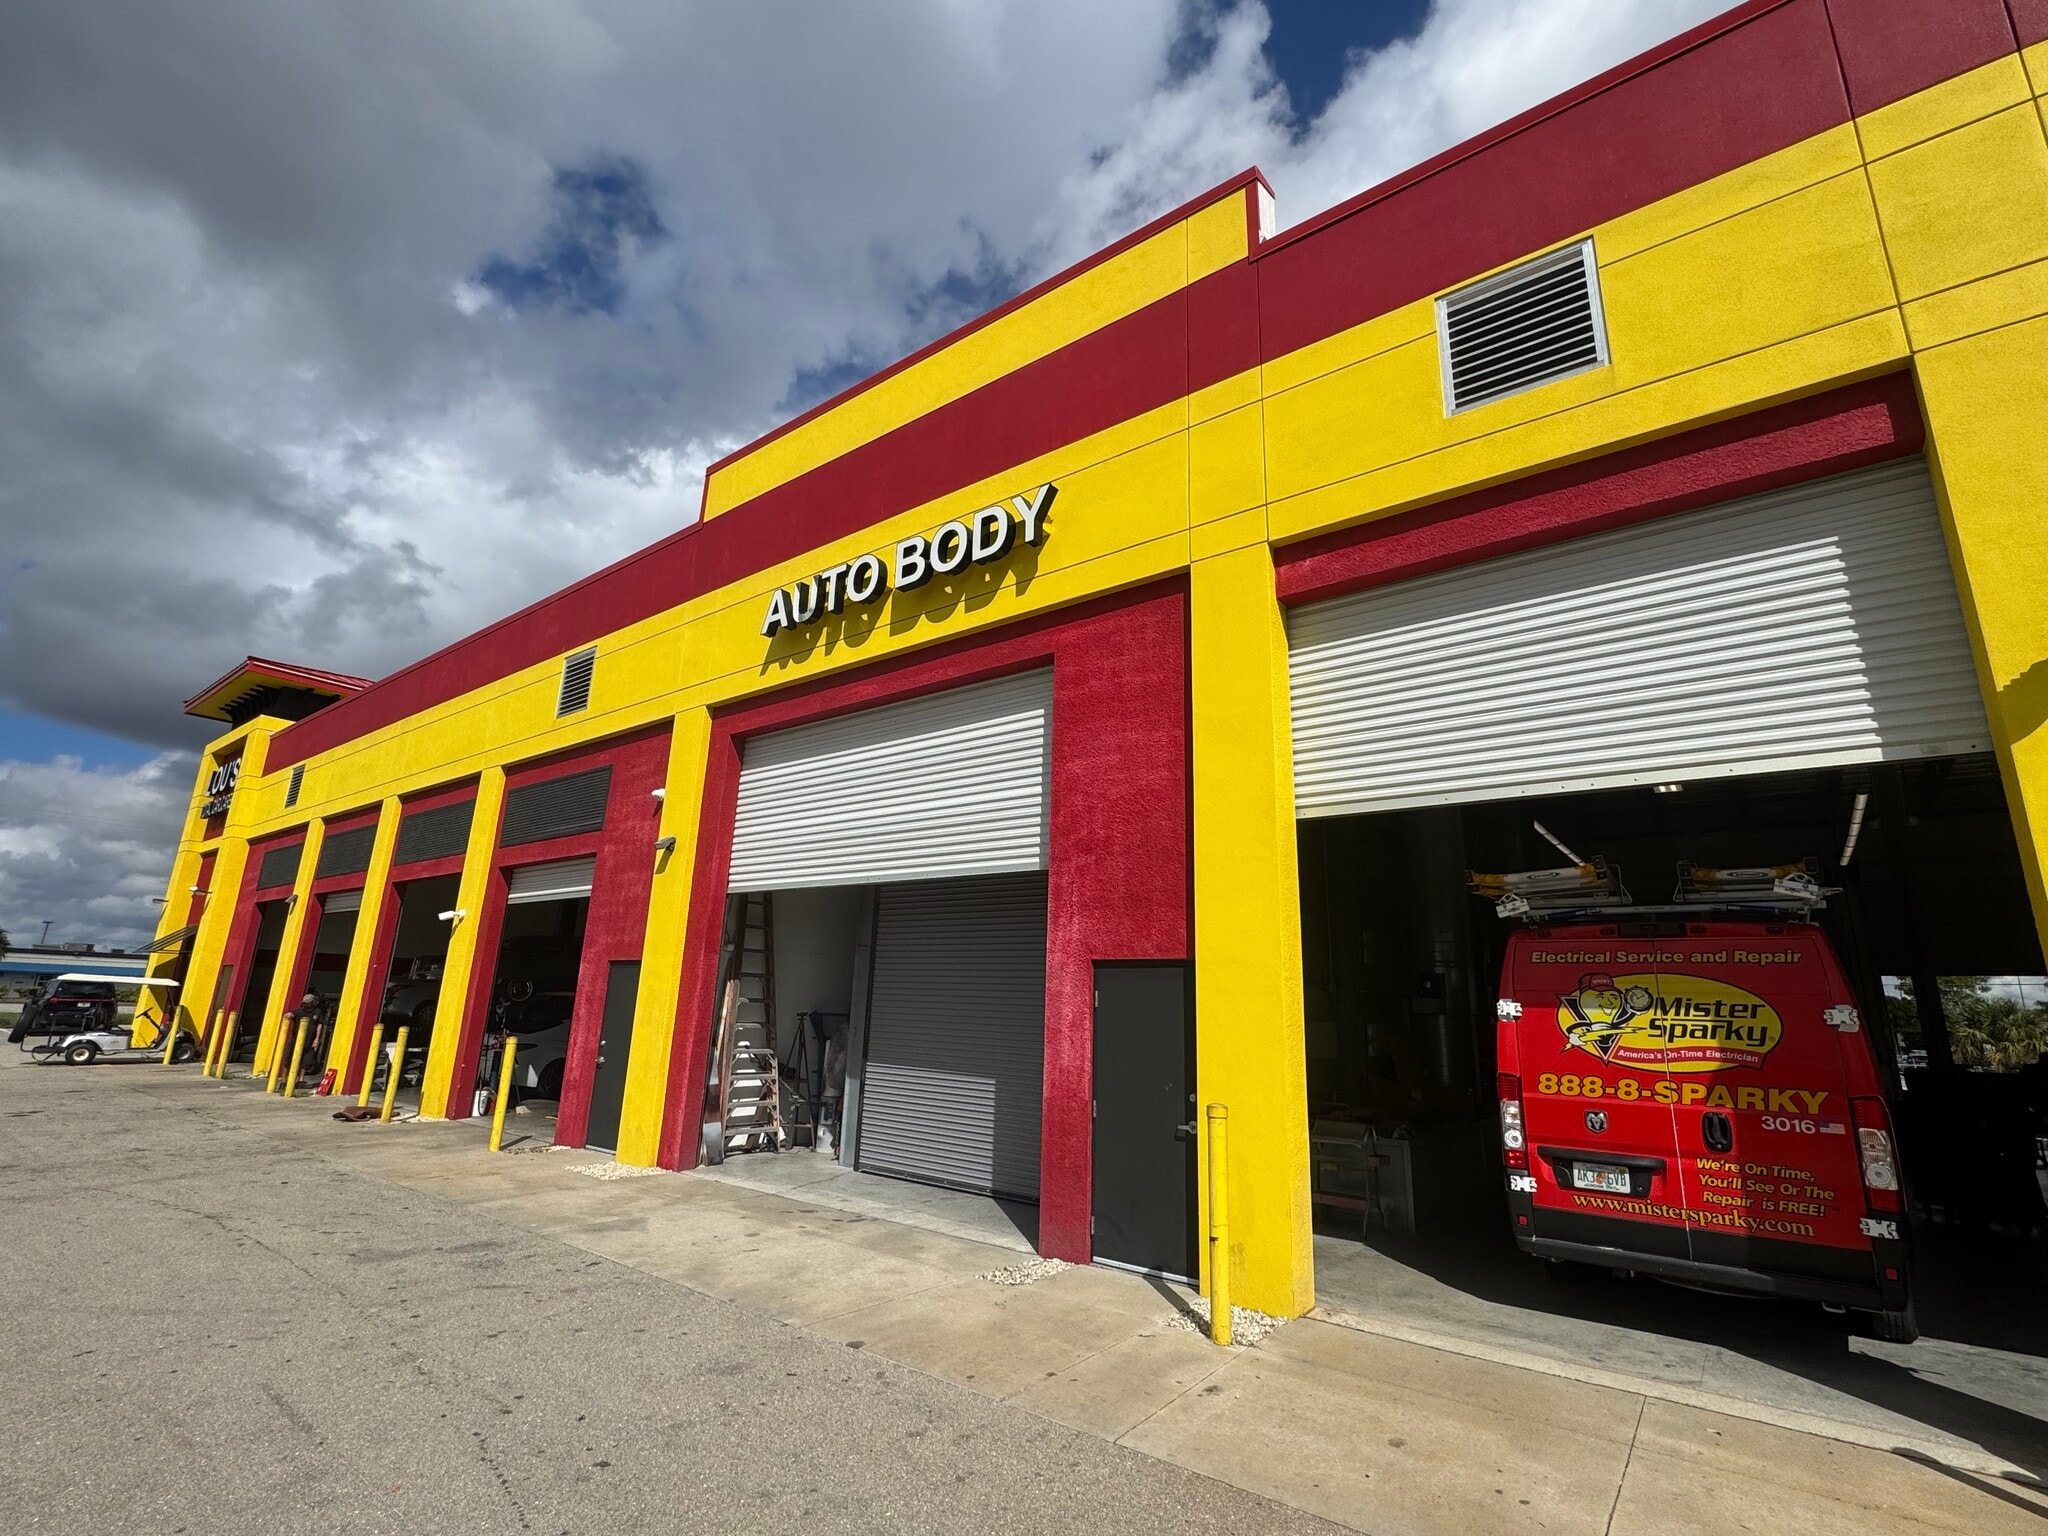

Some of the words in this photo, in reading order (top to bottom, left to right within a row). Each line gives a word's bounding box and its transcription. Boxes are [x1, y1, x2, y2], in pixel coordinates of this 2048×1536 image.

[760, 553, 883, 637] AUTO
[895, 482, 1055, 591] BODY
[1531, 950, 1611, 963] Electrical
[1615, 950, 1685, 964] Service
[1690, 950, 1727, 964] and
[1733, 950, 1803, 967] Repair
[1653, 996, 1766, 1020] Mister
[1647, 1018, 1768, 1048] Sparky
[1617, 1049, 1662, 1060] America's
[1663, 1050, 1705, 1060] On-Time
[1706, 1050, 1759, 1063] Electrician
[1537, 1072, 1830, 1115] 888-8-SPARKY
[1761, 1115, 1816, 1135] 3016
[1696, 1157, 1741, 1173] We're
[1744, 1163, 1768, 1176] On
[1771, 1165, 1815, 1182] Time,
[1699, 1174, 1742, 1190] You'll
[1745, 1179, 1775, 1193] See
[1780, 1183, 1800, 1196] Or
[1804, 1186, 1835, 1200] The
[1573, 1194, 1815, 1237] www.mistersparky.com
[1703, 1191, 1754, 1207] Repair
[1762, 1197, 1775, 1211] is
[1779, 1200, 1825, 1217] FREE!
